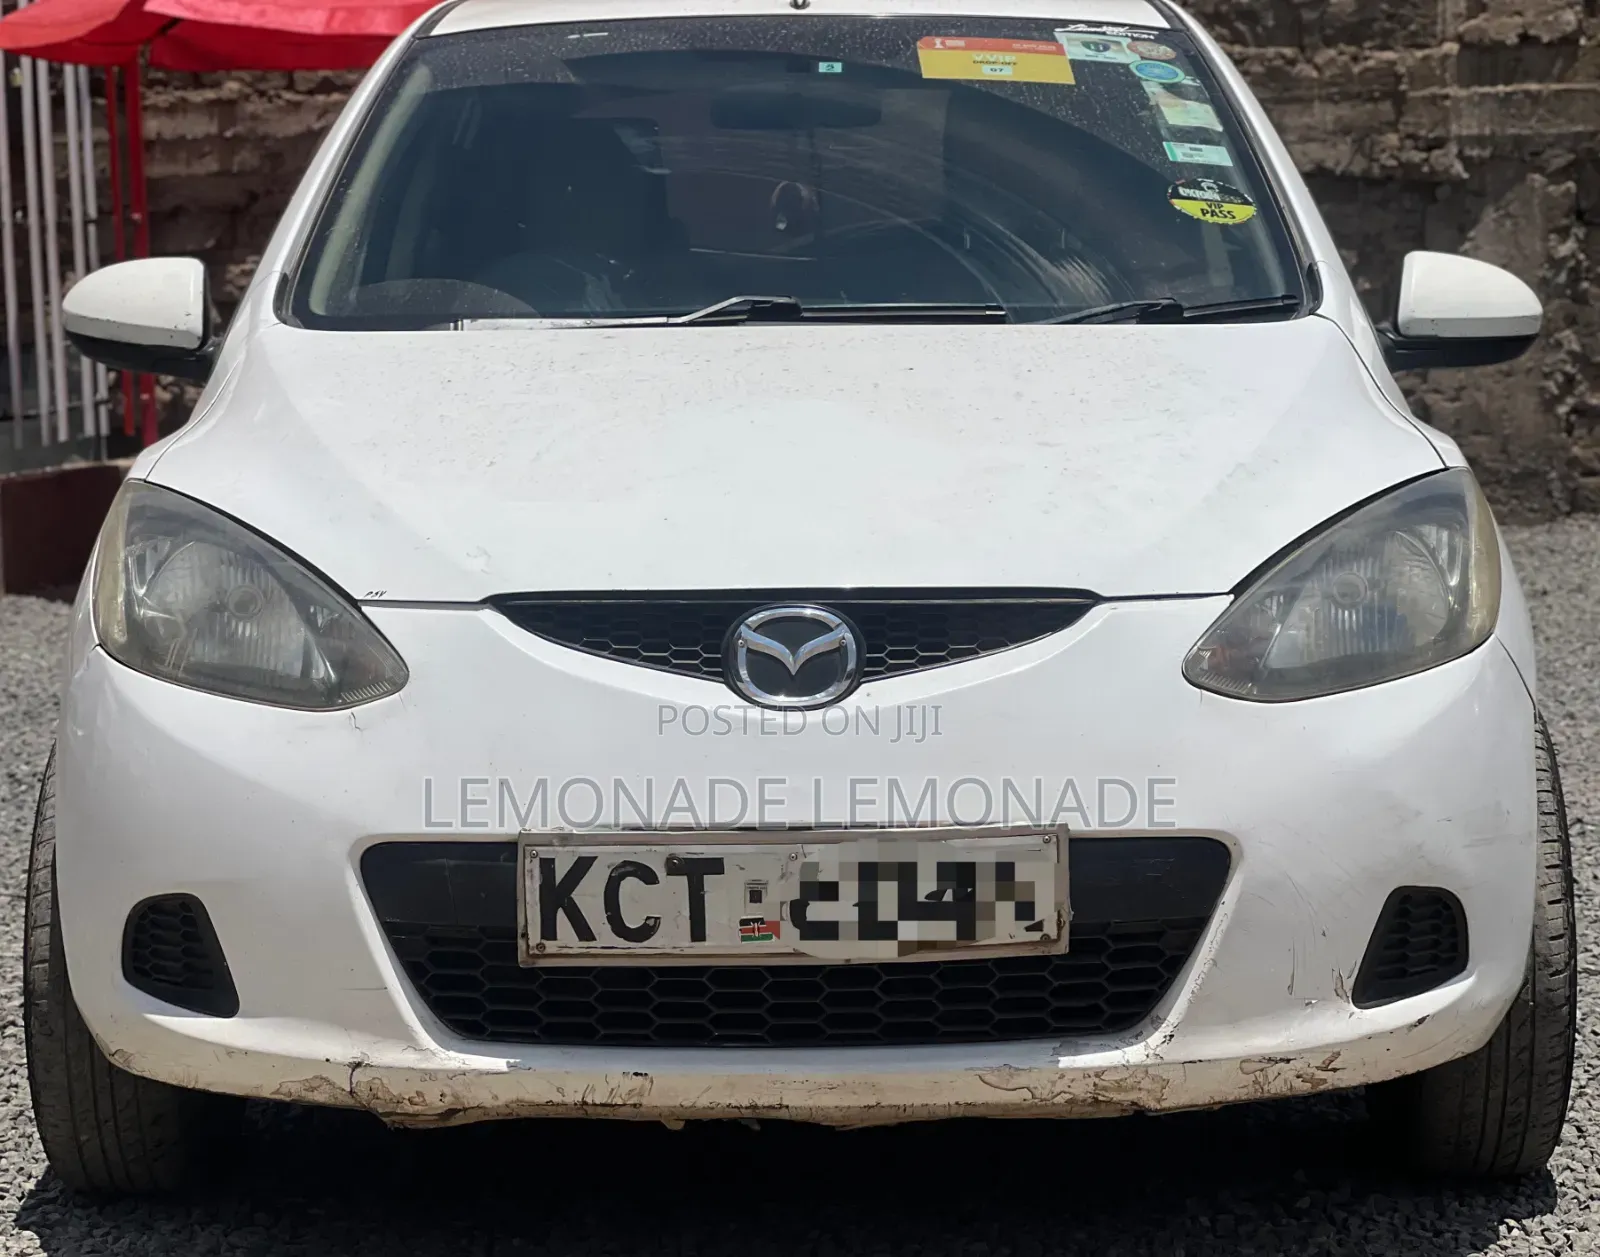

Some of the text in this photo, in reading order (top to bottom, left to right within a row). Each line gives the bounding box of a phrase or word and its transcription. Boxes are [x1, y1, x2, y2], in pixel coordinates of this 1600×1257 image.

[1106, 31, 1155, 40] EDITION
[972, 54, 1017, 62] VVIP
[1206, 202, 1224, 210] VIP
[1200, 208, 1236, 219] PASS
[538, 856, 725, 944] KCT
